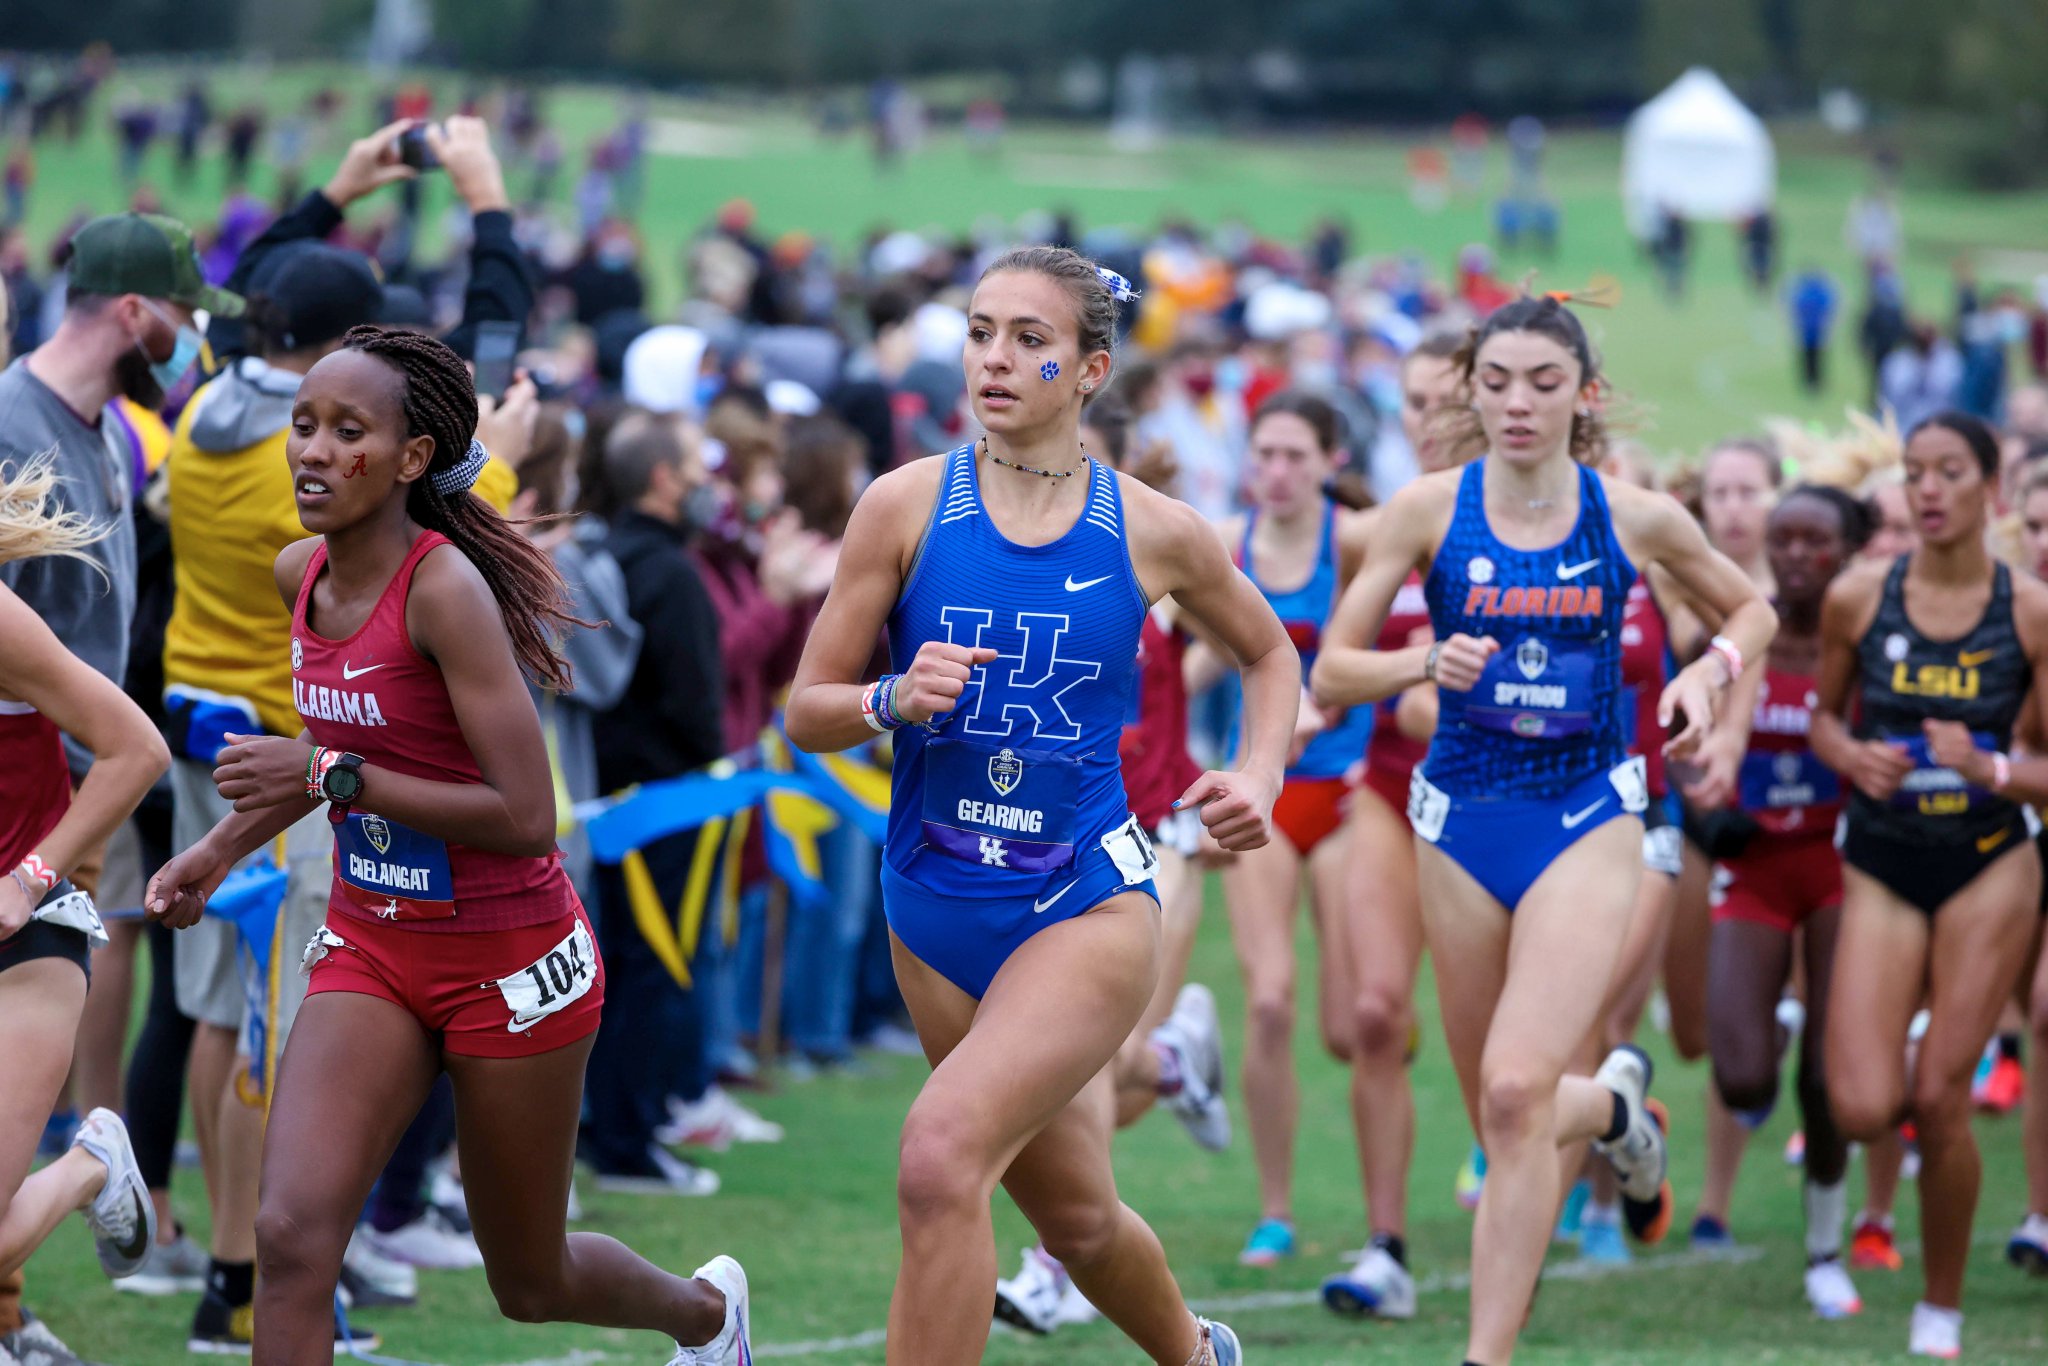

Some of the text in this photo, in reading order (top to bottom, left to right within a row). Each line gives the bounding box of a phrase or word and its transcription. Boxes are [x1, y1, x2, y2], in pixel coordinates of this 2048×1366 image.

[343, 453, 368, 478] A
[1464, 586, 1603, 617] FLORIDA
[1891, 660, 1981, 700] LSU
[957, 798, 1044, 833] GEARING
[1918, 792, 1969, 815] LSU
[978, 835, 1009, 868] UK
[525, 935, 588, 1008] 104
